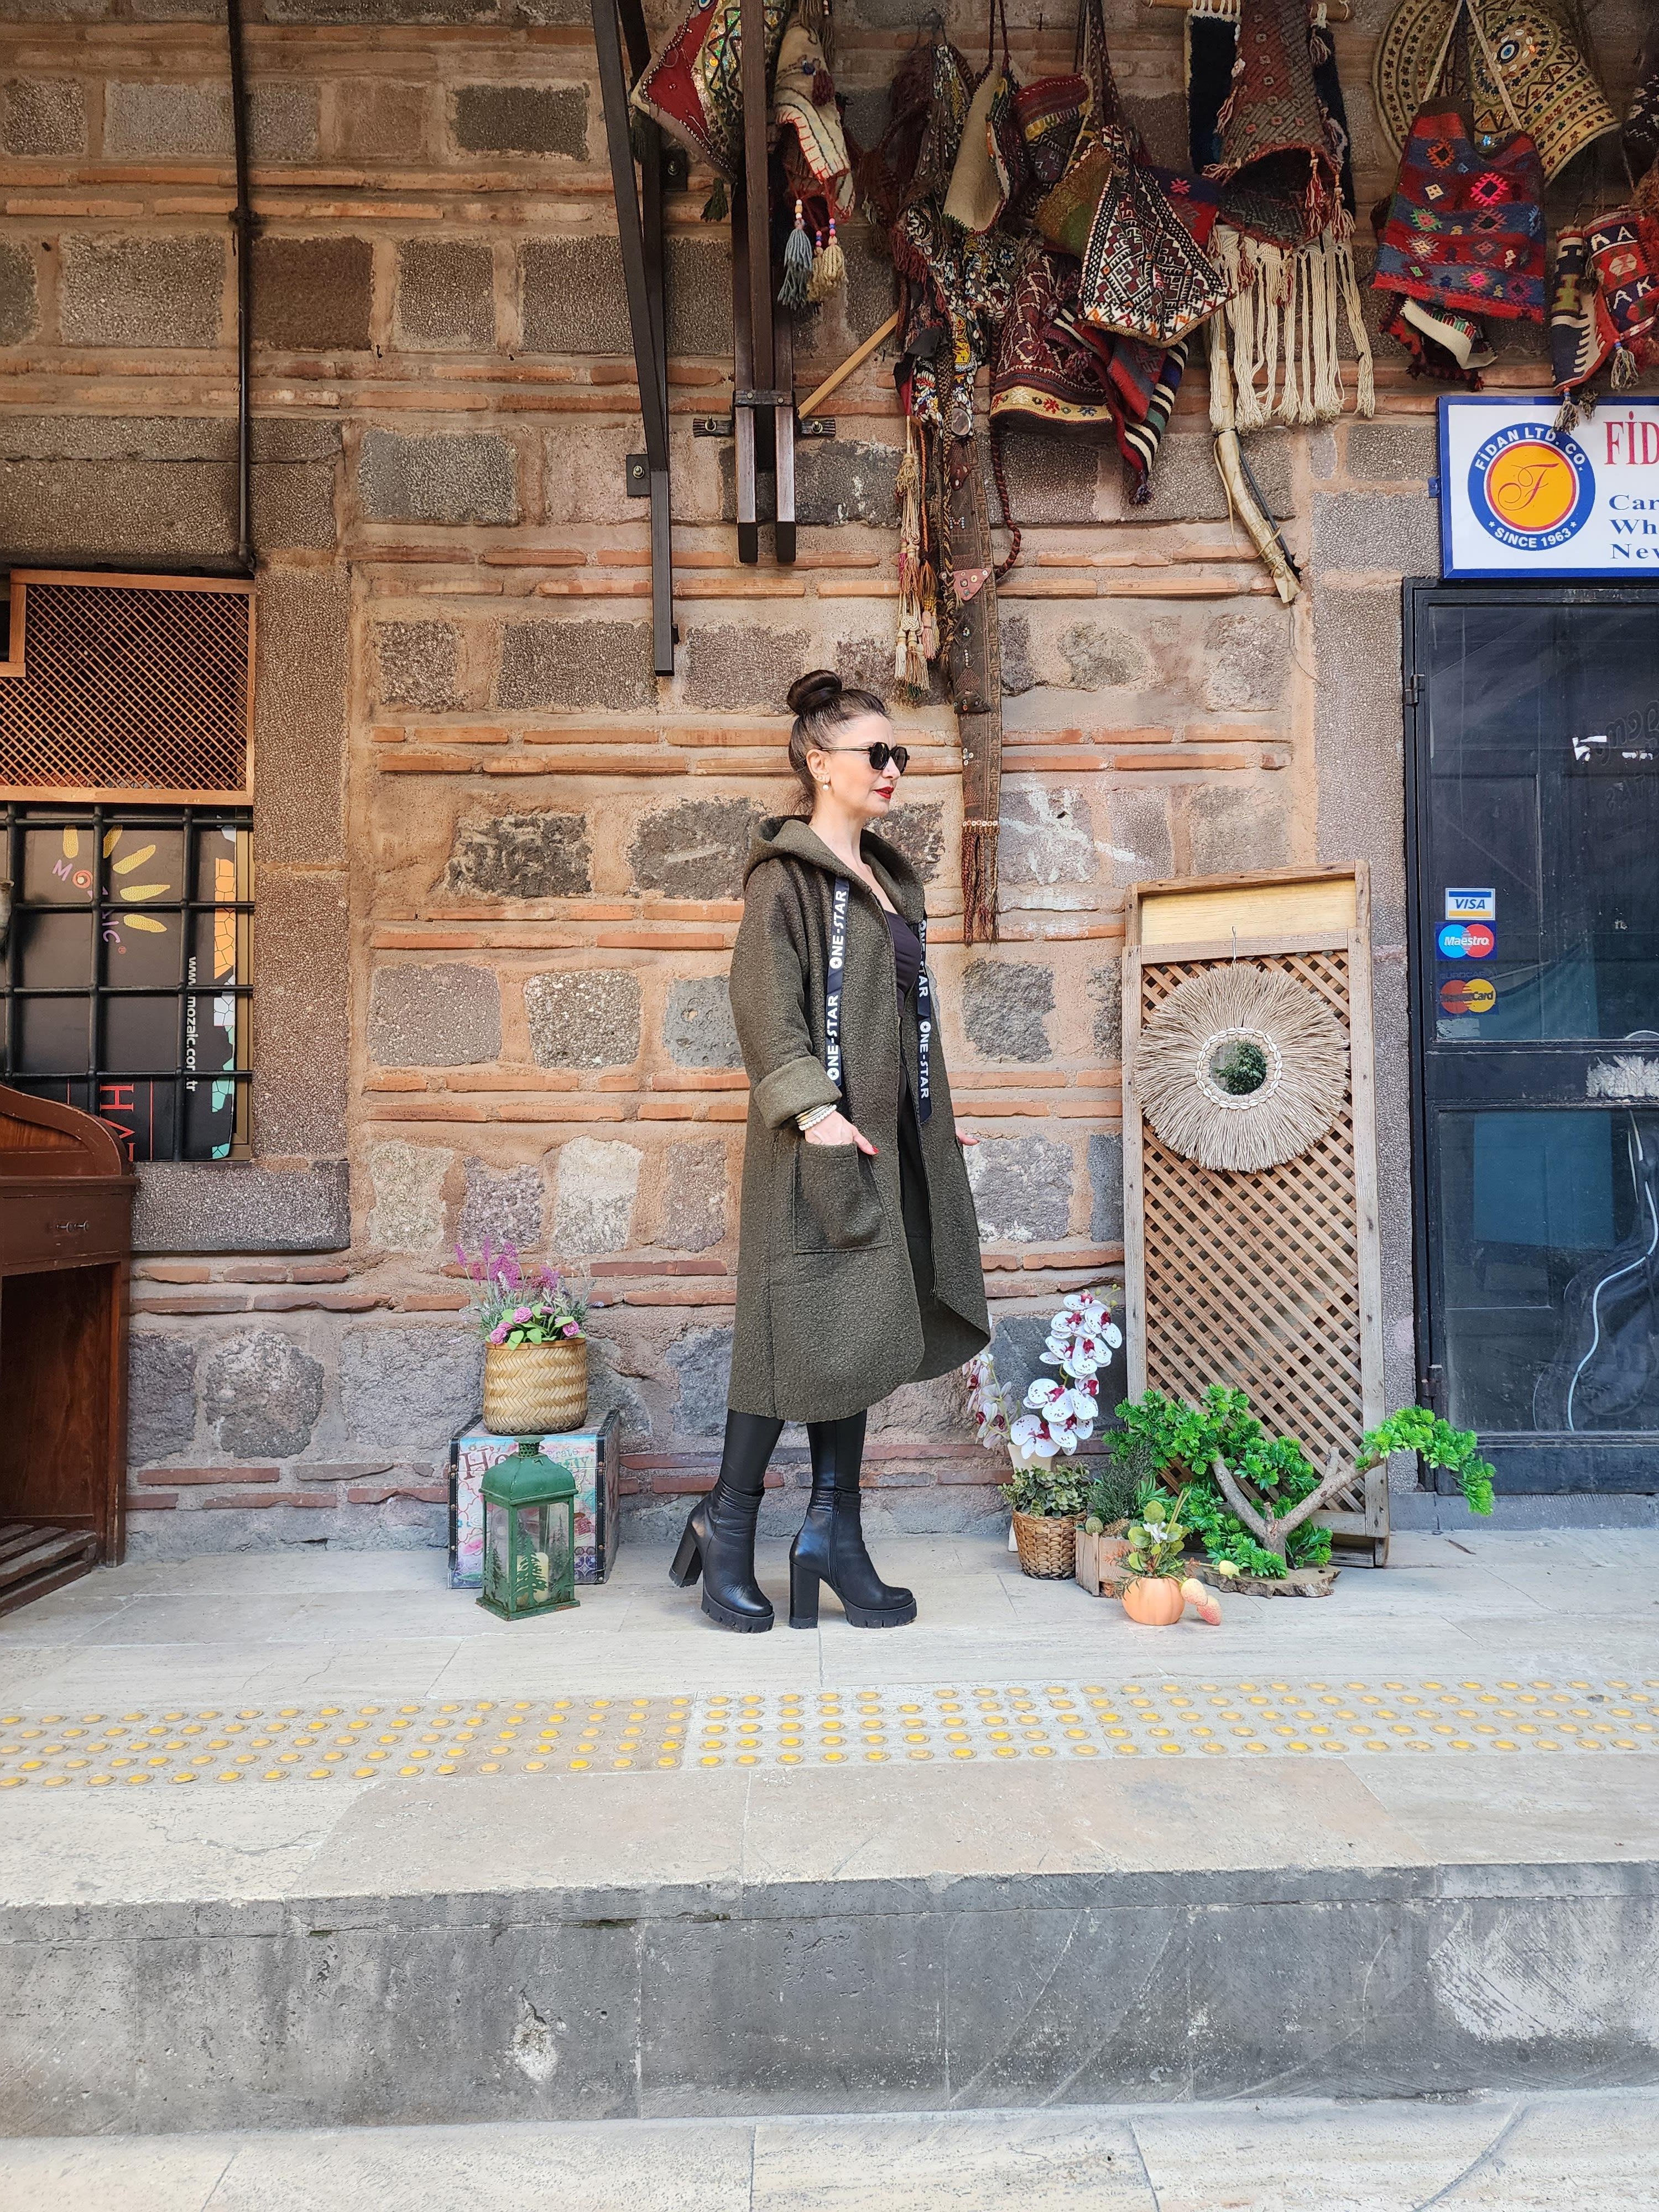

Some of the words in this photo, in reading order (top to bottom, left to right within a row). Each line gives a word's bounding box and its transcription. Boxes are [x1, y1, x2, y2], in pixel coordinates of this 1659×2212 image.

[1525, 427, 1559, 445] LTD.
[1565, 444, 1585, 471] CO.
[1494, 527, 1537, 548] SINCE
[1541, 528, 1571, 546] 1963
[1609, 519, 1659, 535] Wh
[1454, 899, 1485, 910] VISA
[830, 890, 847, 969] ONE-STAR
[1444, 936, 1490, 946] Maestro
[827, 995, 839, 1080] ONE-STAR
[920, 1021, 931, 1099] ONE-STAR
